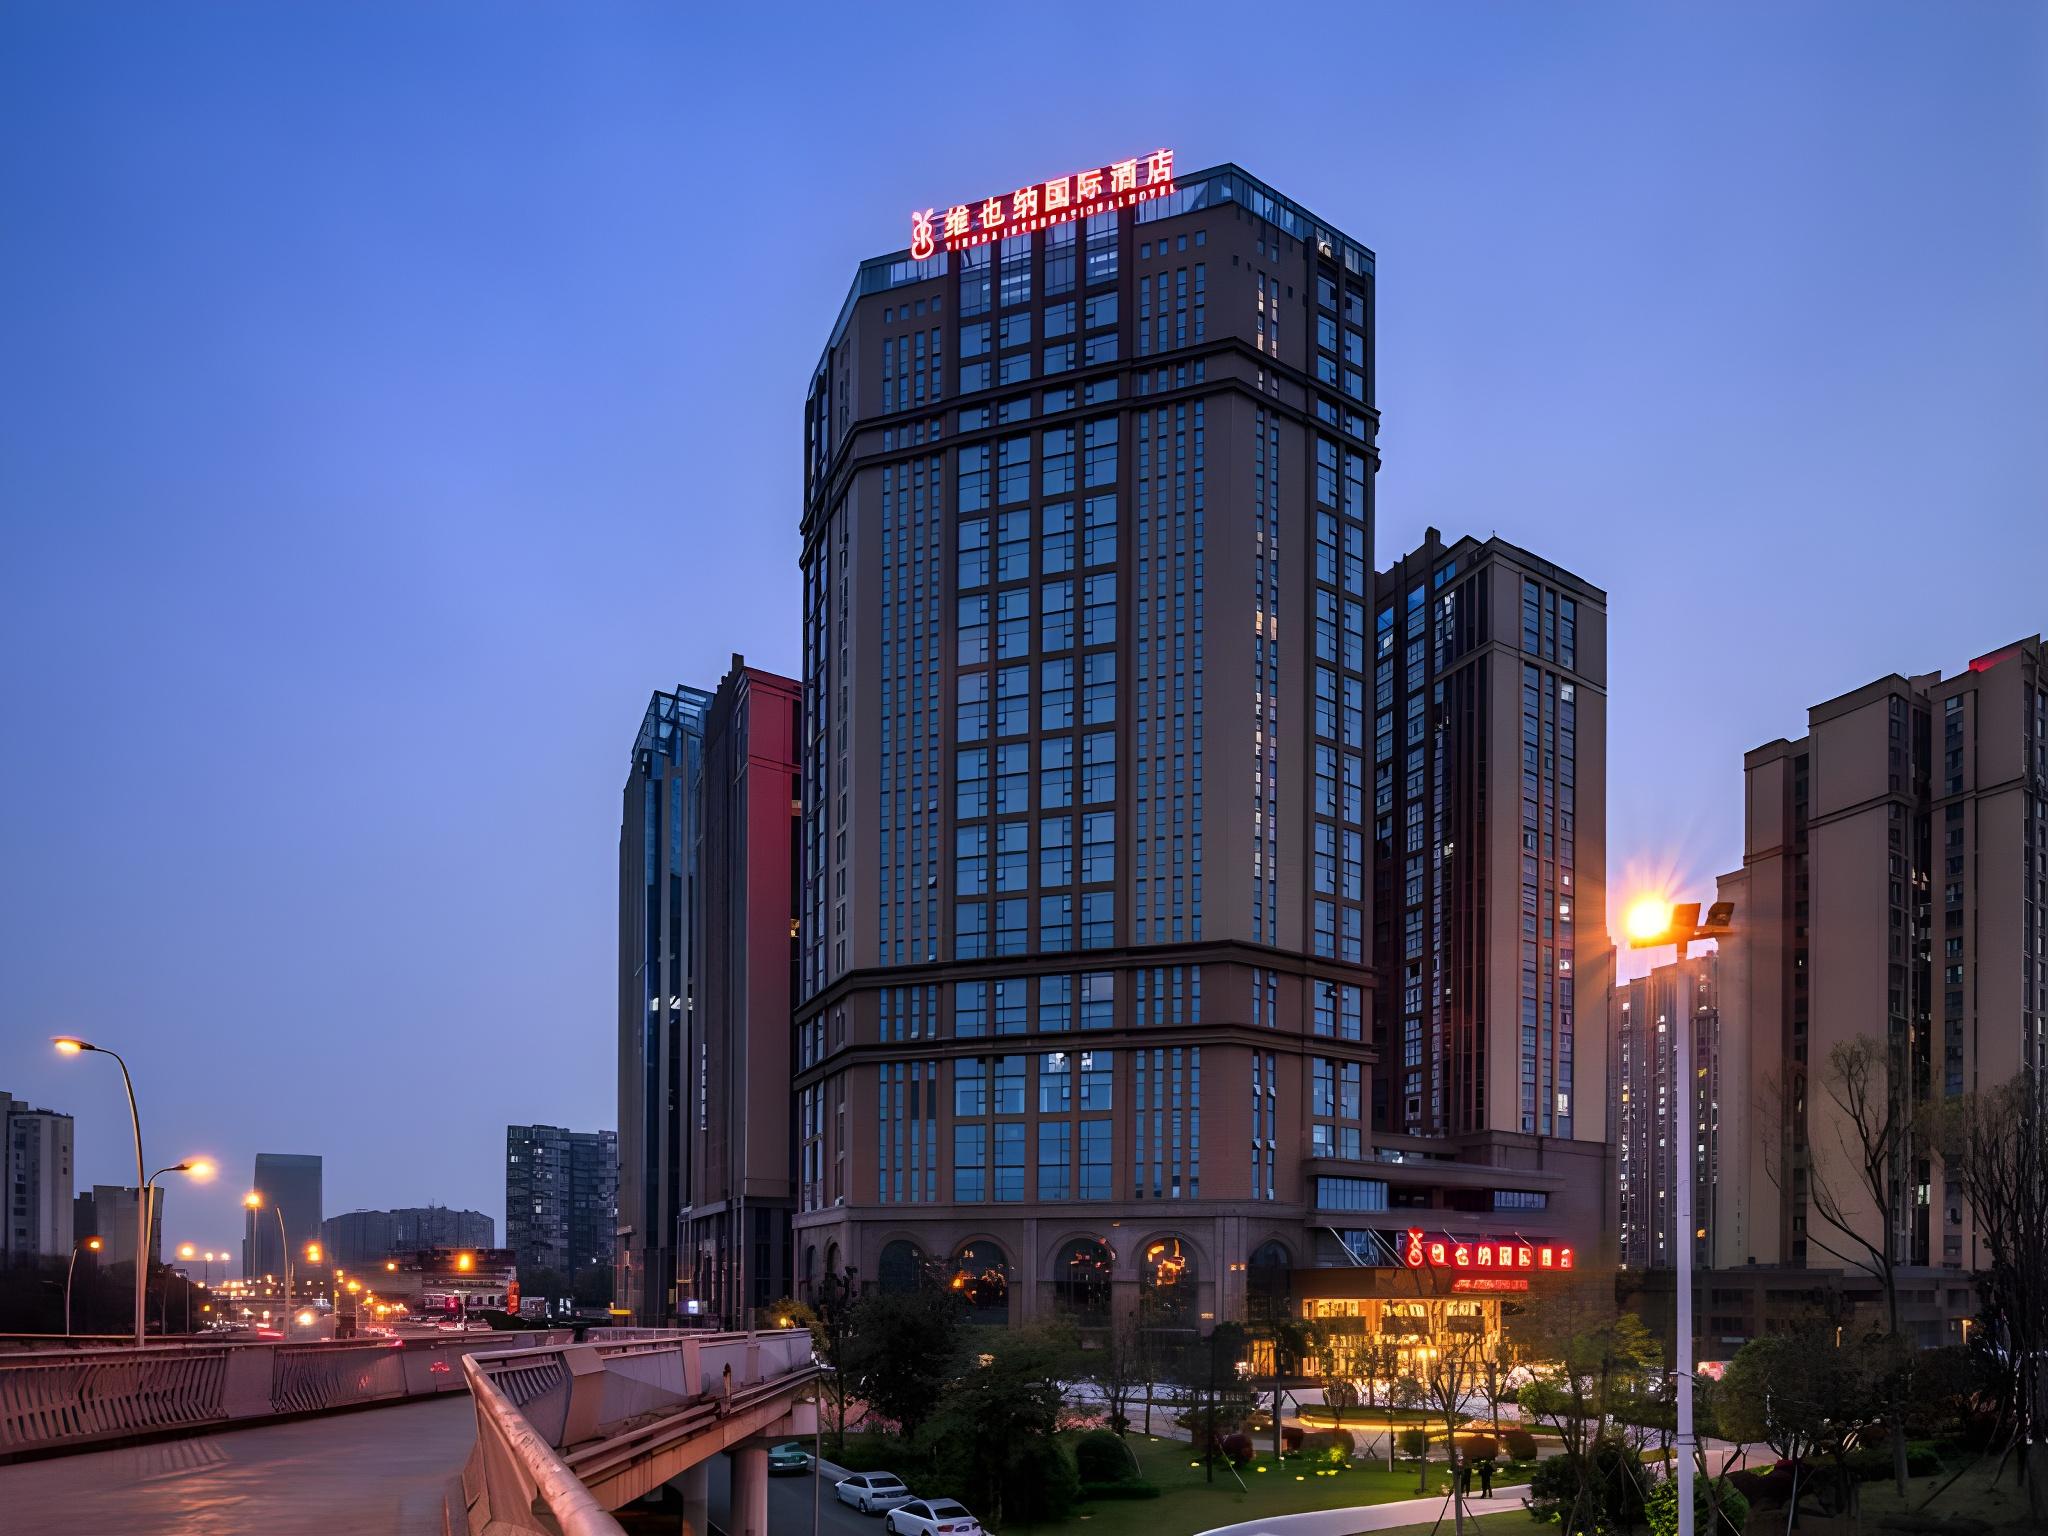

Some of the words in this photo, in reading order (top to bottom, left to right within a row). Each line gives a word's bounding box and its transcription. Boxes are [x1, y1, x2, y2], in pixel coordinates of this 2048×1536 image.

[943, 148, 1174, 238] 维也纳国际酒店
